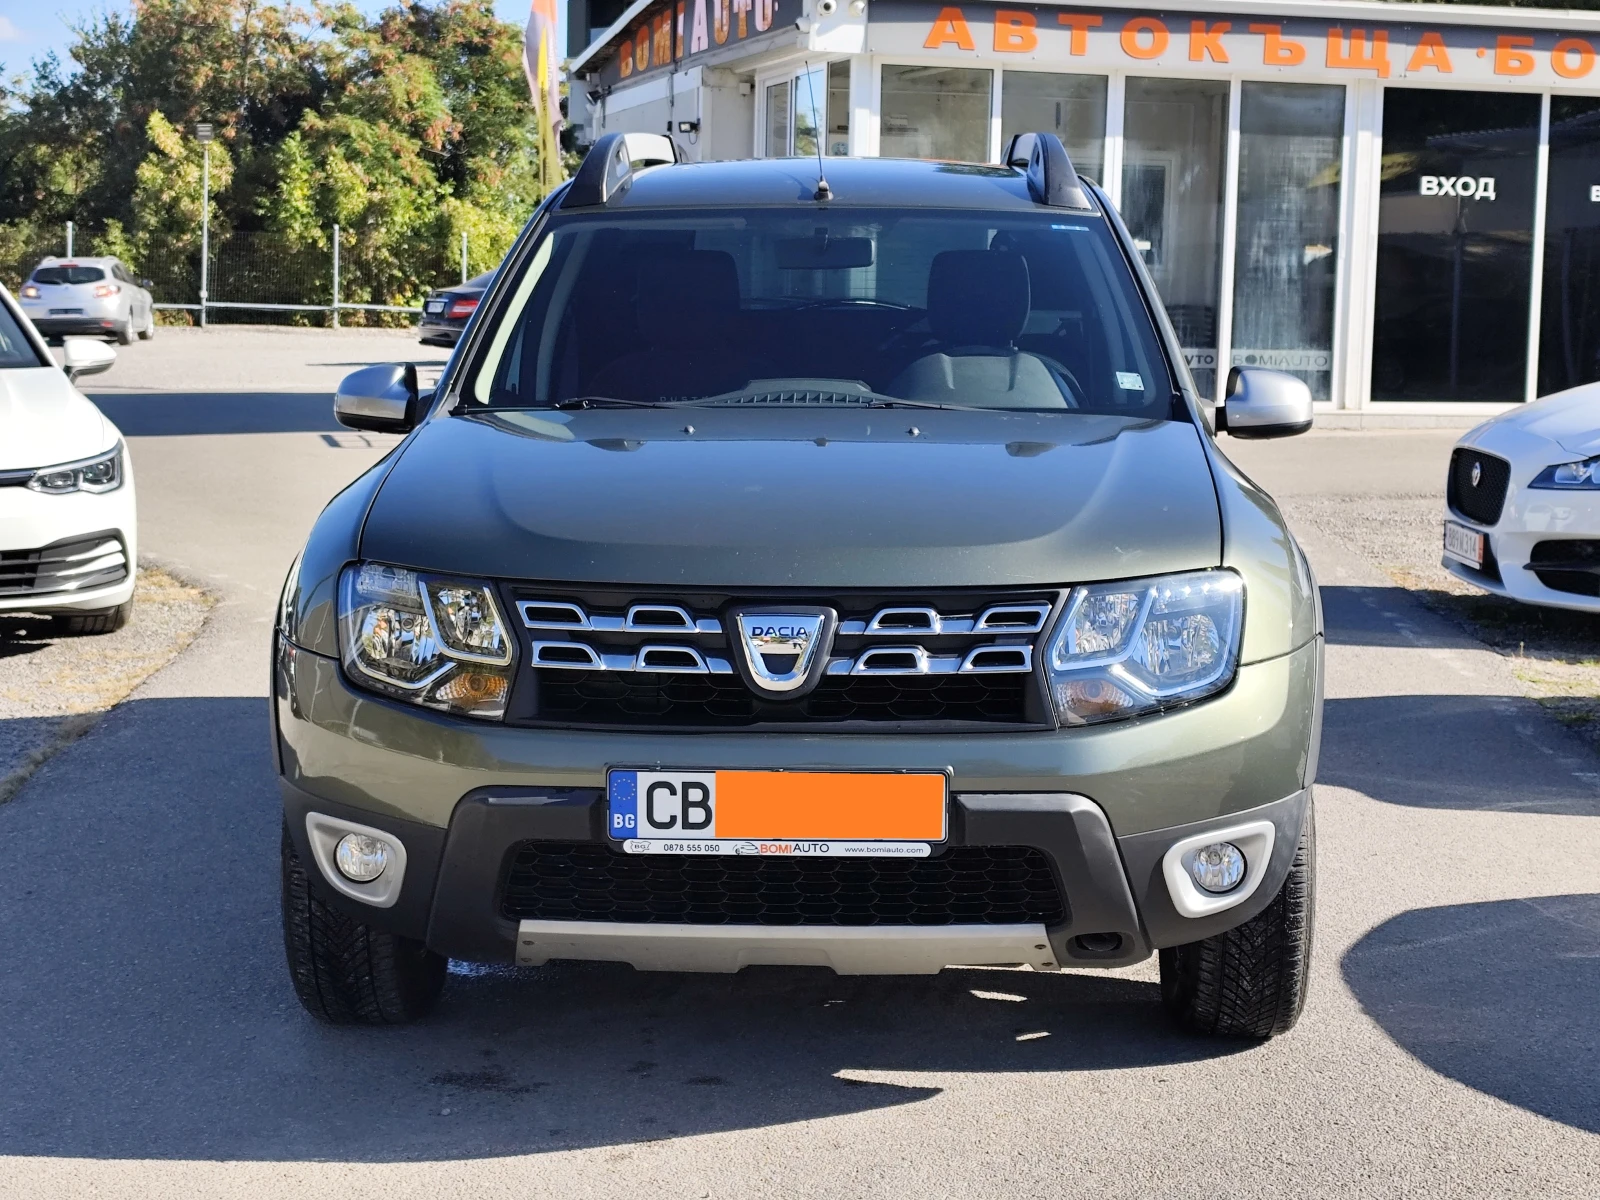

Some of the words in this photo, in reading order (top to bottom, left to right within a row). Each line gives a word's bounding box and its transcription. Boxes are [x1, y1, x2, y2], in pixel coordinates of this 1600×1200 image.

[1421, 176, 1496, 201] ВХОД
[751, 626, 808, 637] DACIA
[613, 812, 635, 829] BG
[663, 843, 685, 852] 0878
[686, 844, 702, 852] 555
[704, 844, 720, 852] 050
[844, 846, 924, 854] www.bomiauto.com
